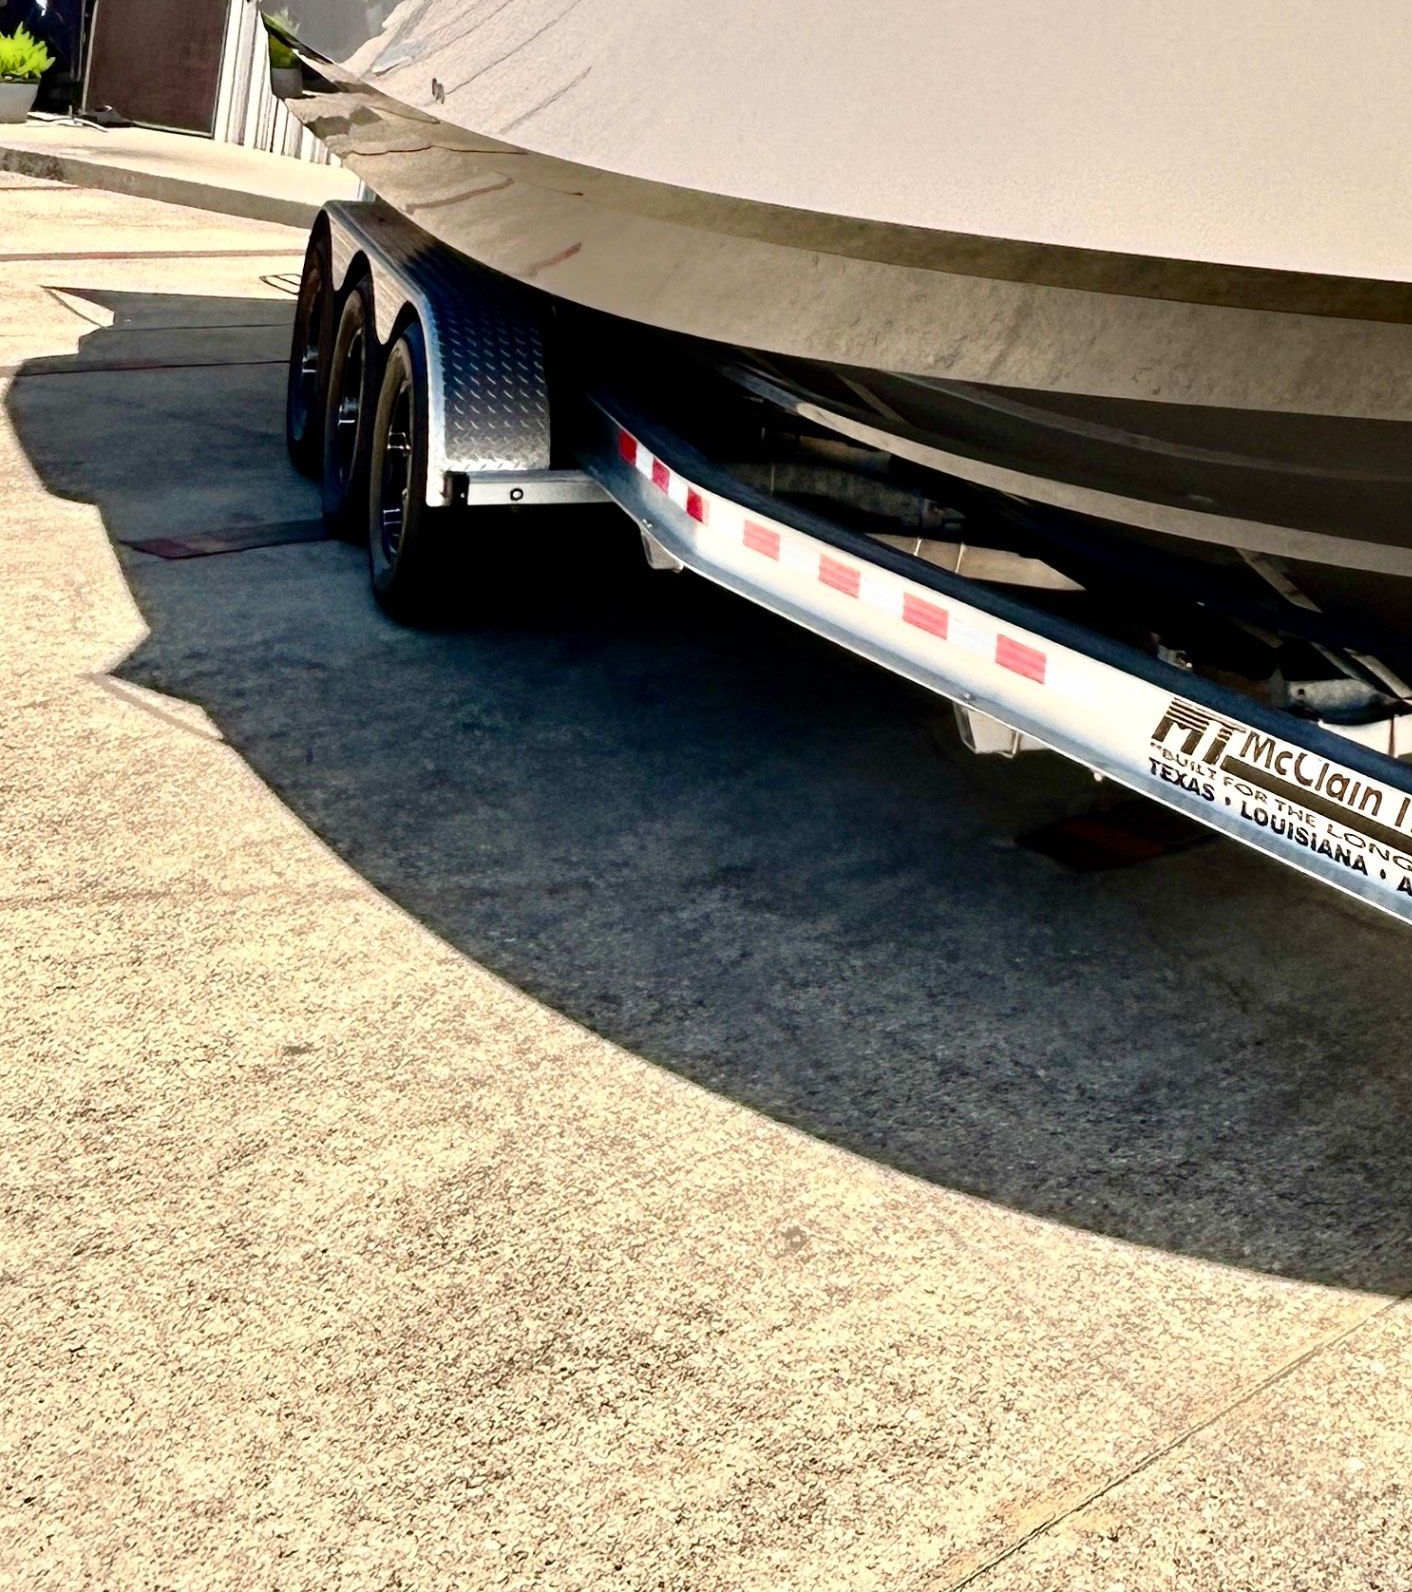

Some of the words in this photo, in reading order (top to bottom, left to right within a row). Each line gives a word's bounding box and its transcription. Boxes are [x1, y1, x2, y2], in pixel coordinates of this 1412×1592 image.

[1223, 776, 1268, 805] FOR
[1275, 798, 1317, 828] THE
[1240, 730, 1382, 816] McClain
[1149, 757, 1215, 801] TEXAS
[1240, 801, 1368, 876] LOUISIANA
